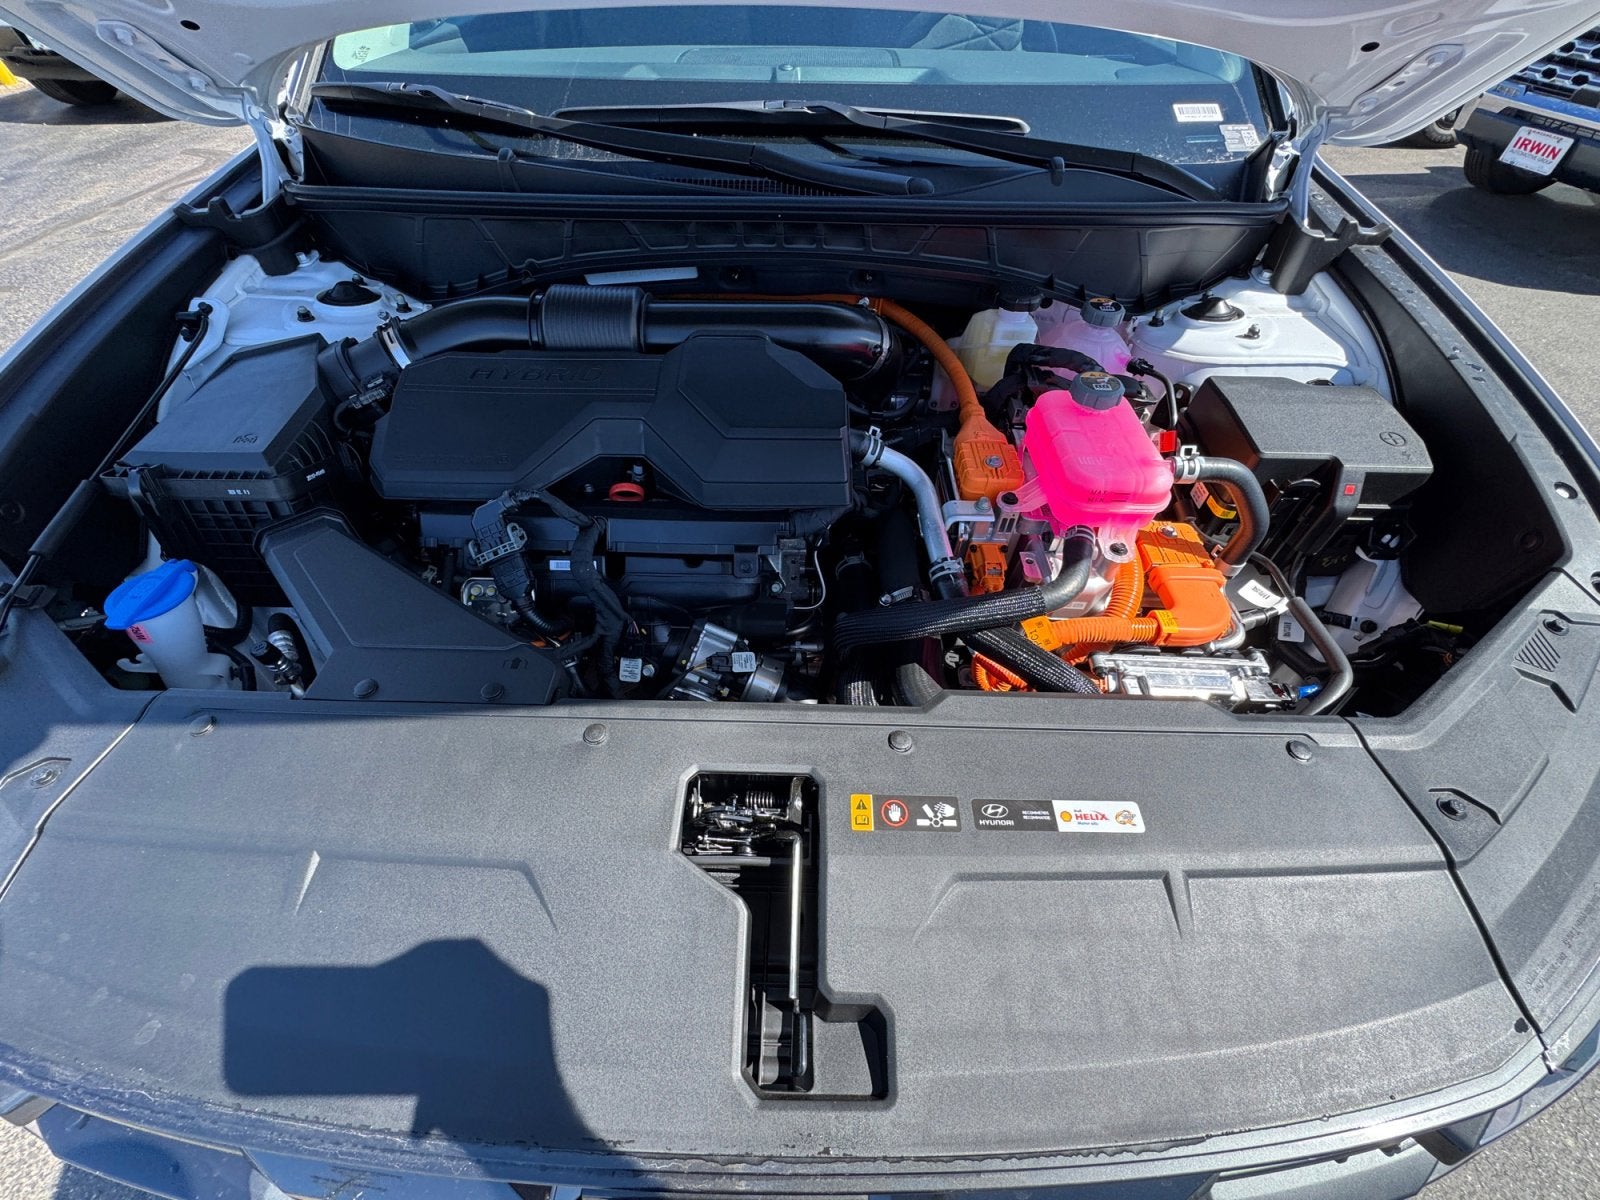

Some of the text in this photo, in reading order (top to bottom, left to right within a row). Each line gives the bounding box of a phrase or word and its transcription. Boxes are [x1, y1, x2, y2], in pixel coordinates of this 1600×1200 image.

[1513, 136, 1562, 160] IRWIN
[469, 367, 601, 382] HYBRID
[1075, 813, 1109, 821] HELIX
